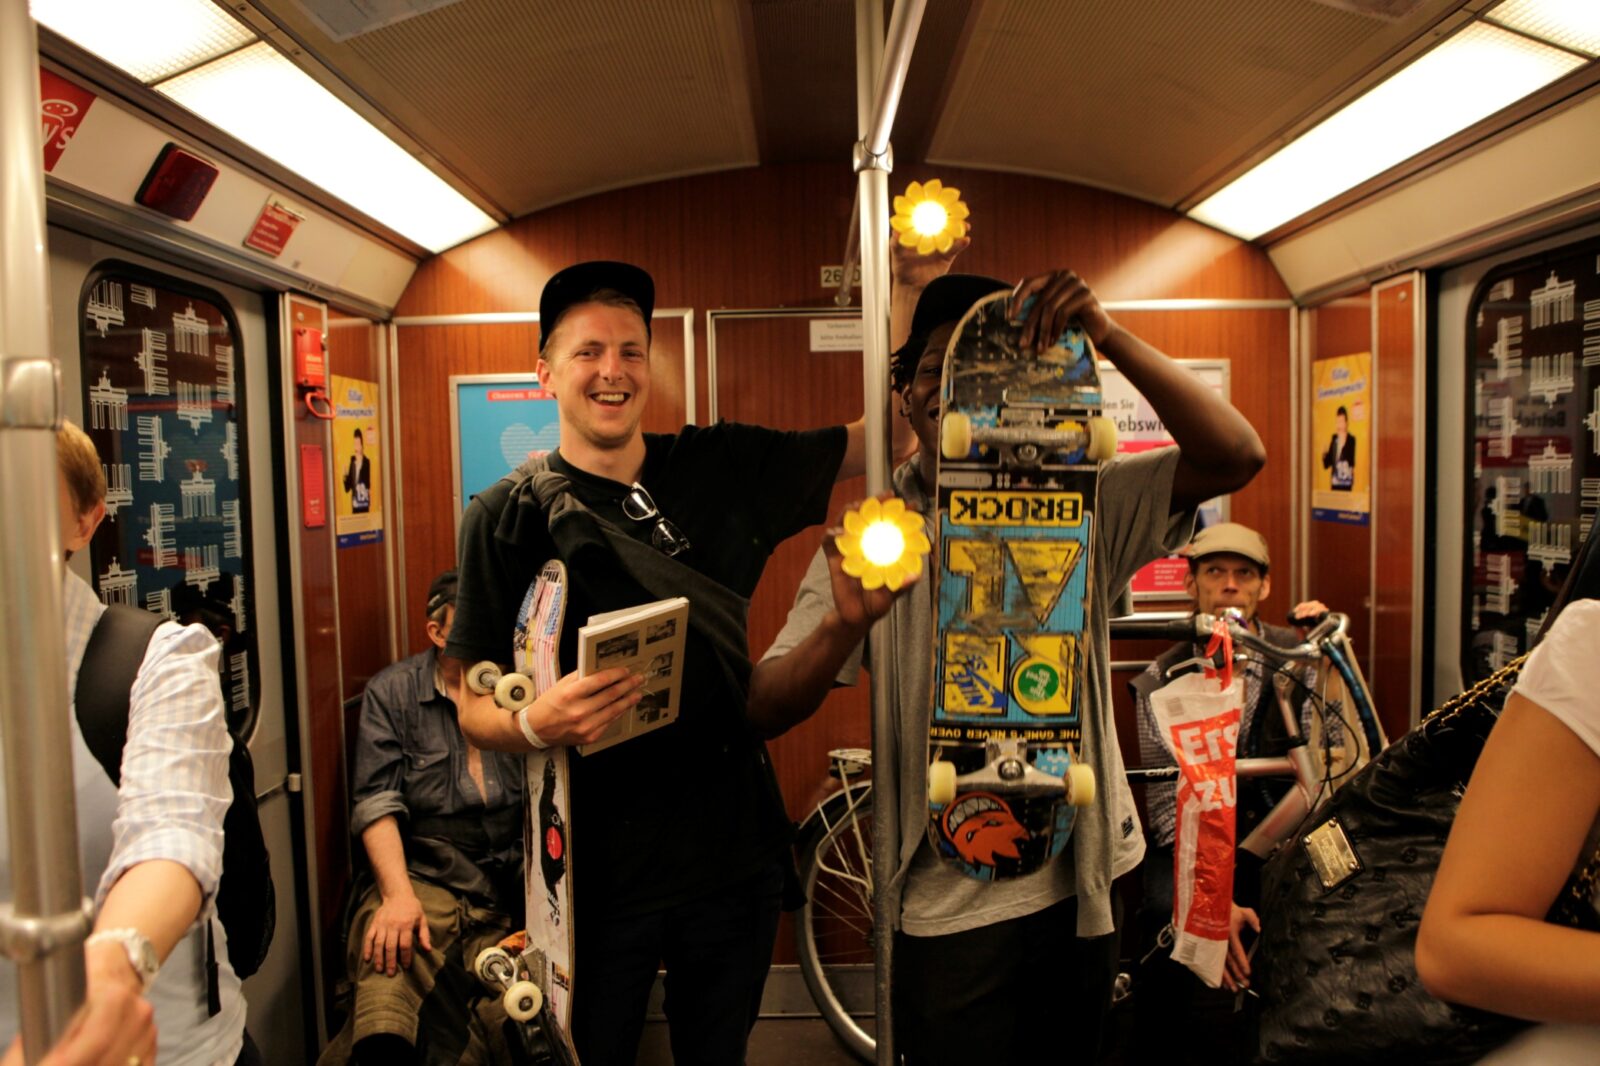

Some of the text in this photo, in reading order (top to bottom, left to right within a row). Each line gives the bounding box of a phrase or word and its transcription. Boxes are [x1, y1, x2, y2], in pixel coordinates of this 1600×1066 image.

[953, 496, 1079, 521] BROCK
[929, 726, 962, 738] OVER
[967, 728, 1006, 740] NEVER
[1060, 728, 1080, 739] THE
